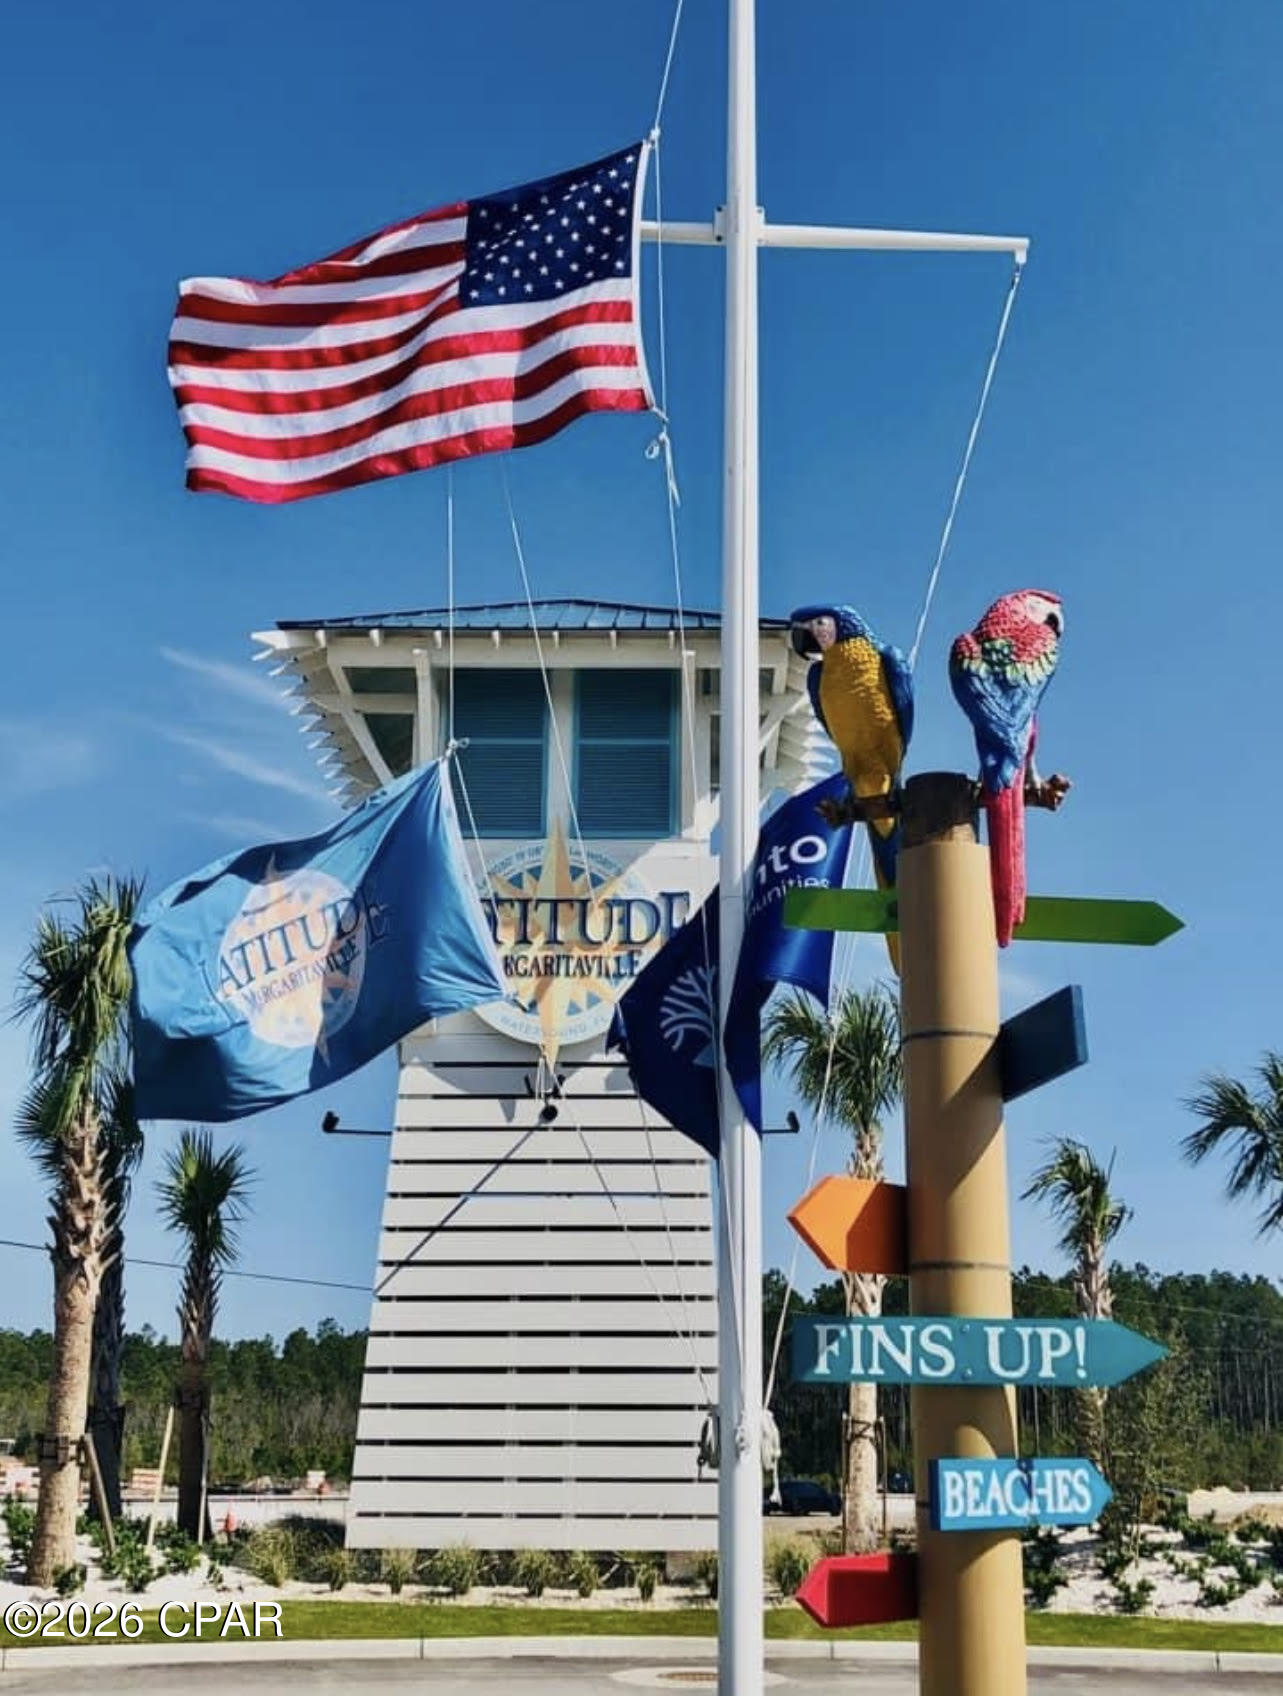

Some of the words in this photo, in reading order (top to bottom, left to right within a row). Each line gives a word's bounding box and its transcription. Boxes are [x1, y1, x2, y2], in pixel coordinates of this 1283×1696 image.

[480, 891, 690, 945] TITUDE
[198, 885, 394, 1027] LATITUDE
[813, 1323, 957, 1378] FINS
[983, 1325, 1089, 1379] UP!
[943, 1467, 1092, 1519] BEACHES
